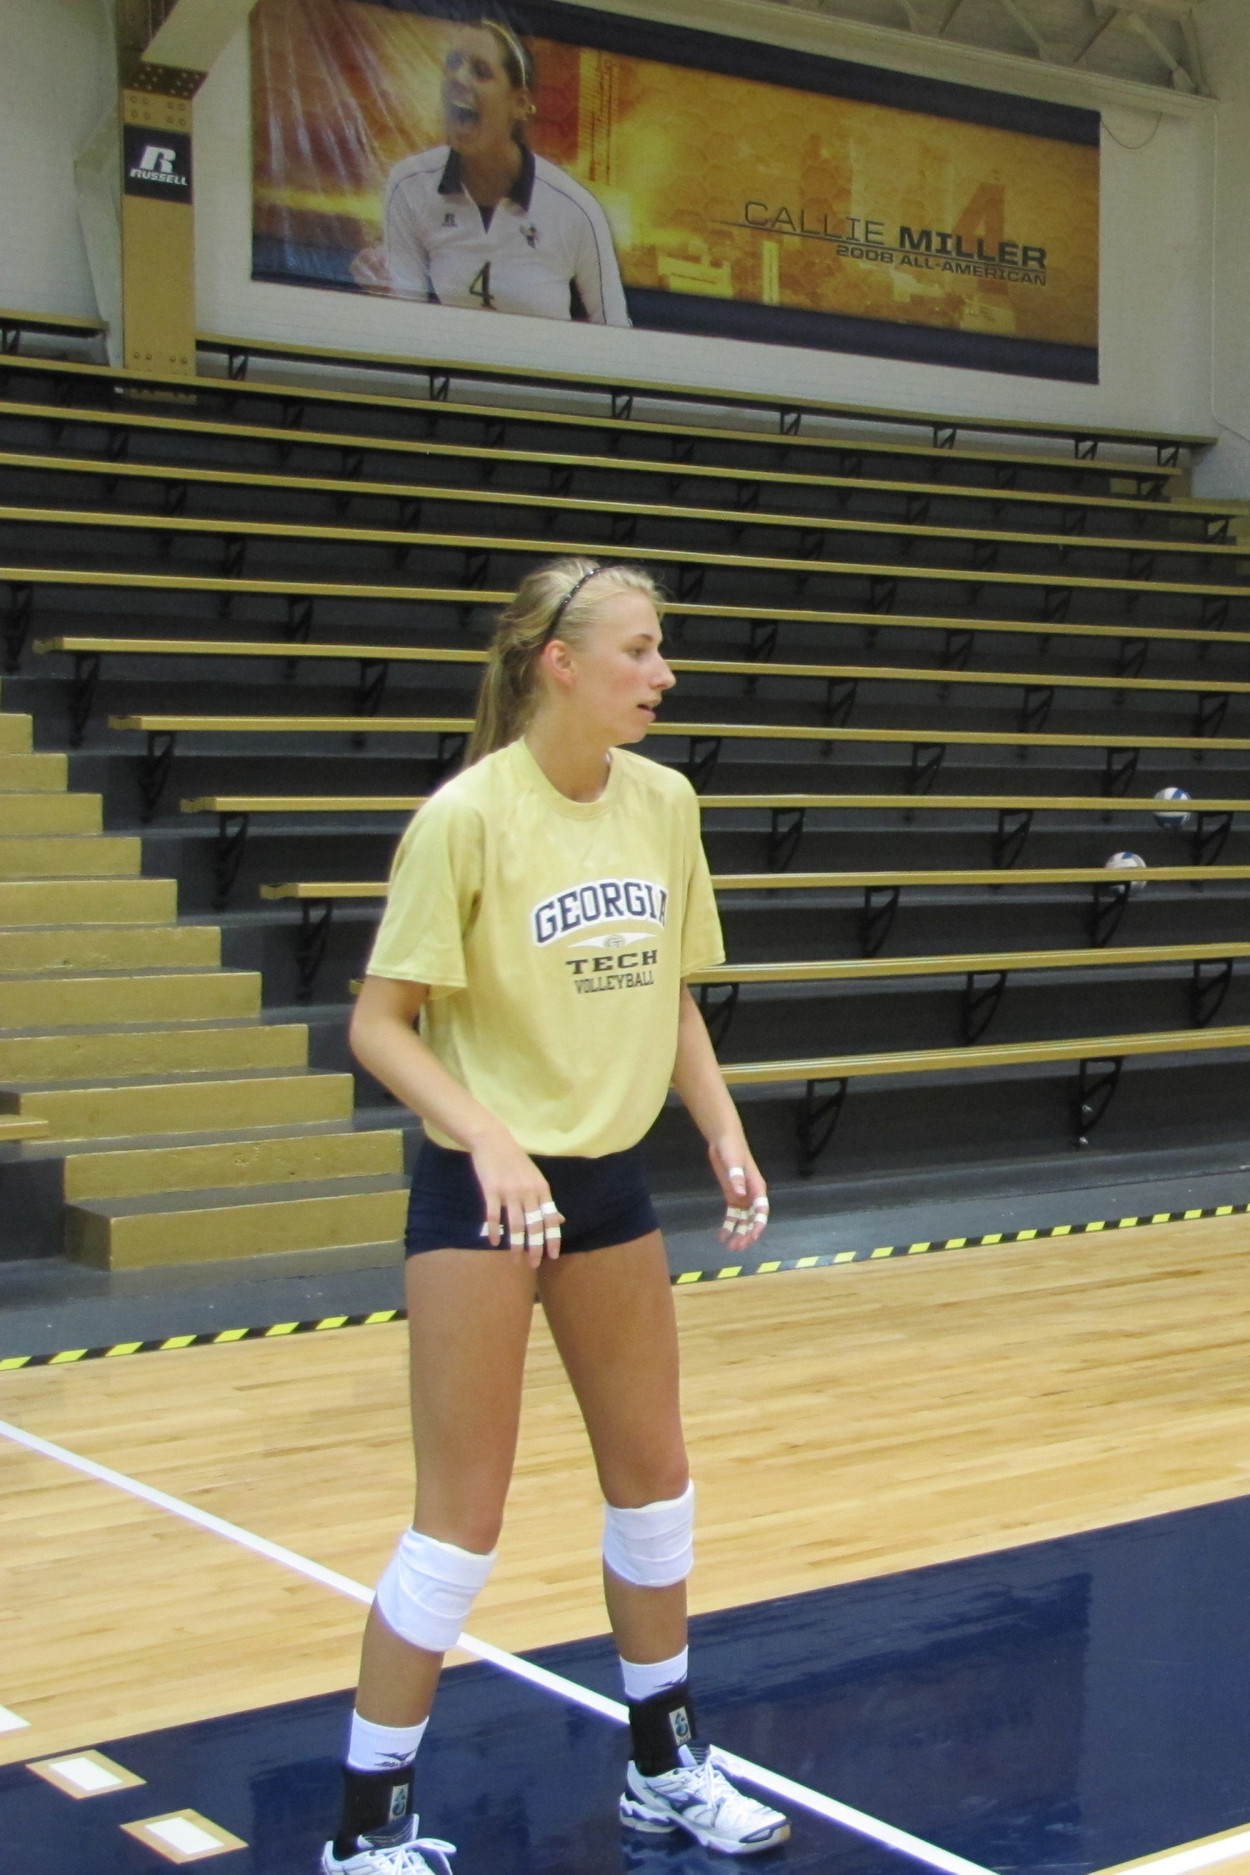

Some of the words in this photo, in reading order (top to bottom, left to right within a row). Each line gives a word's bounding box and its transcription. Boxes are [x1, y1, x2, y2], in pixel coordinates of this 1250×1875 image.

[129, 169, 188, 186] RUSSELL
[744, 201, 885, 245] CALLIE
[900, 226, 1047, 269] MILLER
[837, 245, 893, 263] 2008
[901, 255, 1046, 286] ALL-AMERICAN
[469, 260, 497, 310] 4
[565, 950, 658, 975] TECH
[574, 971, 655, 994] VOLLEYBALL
